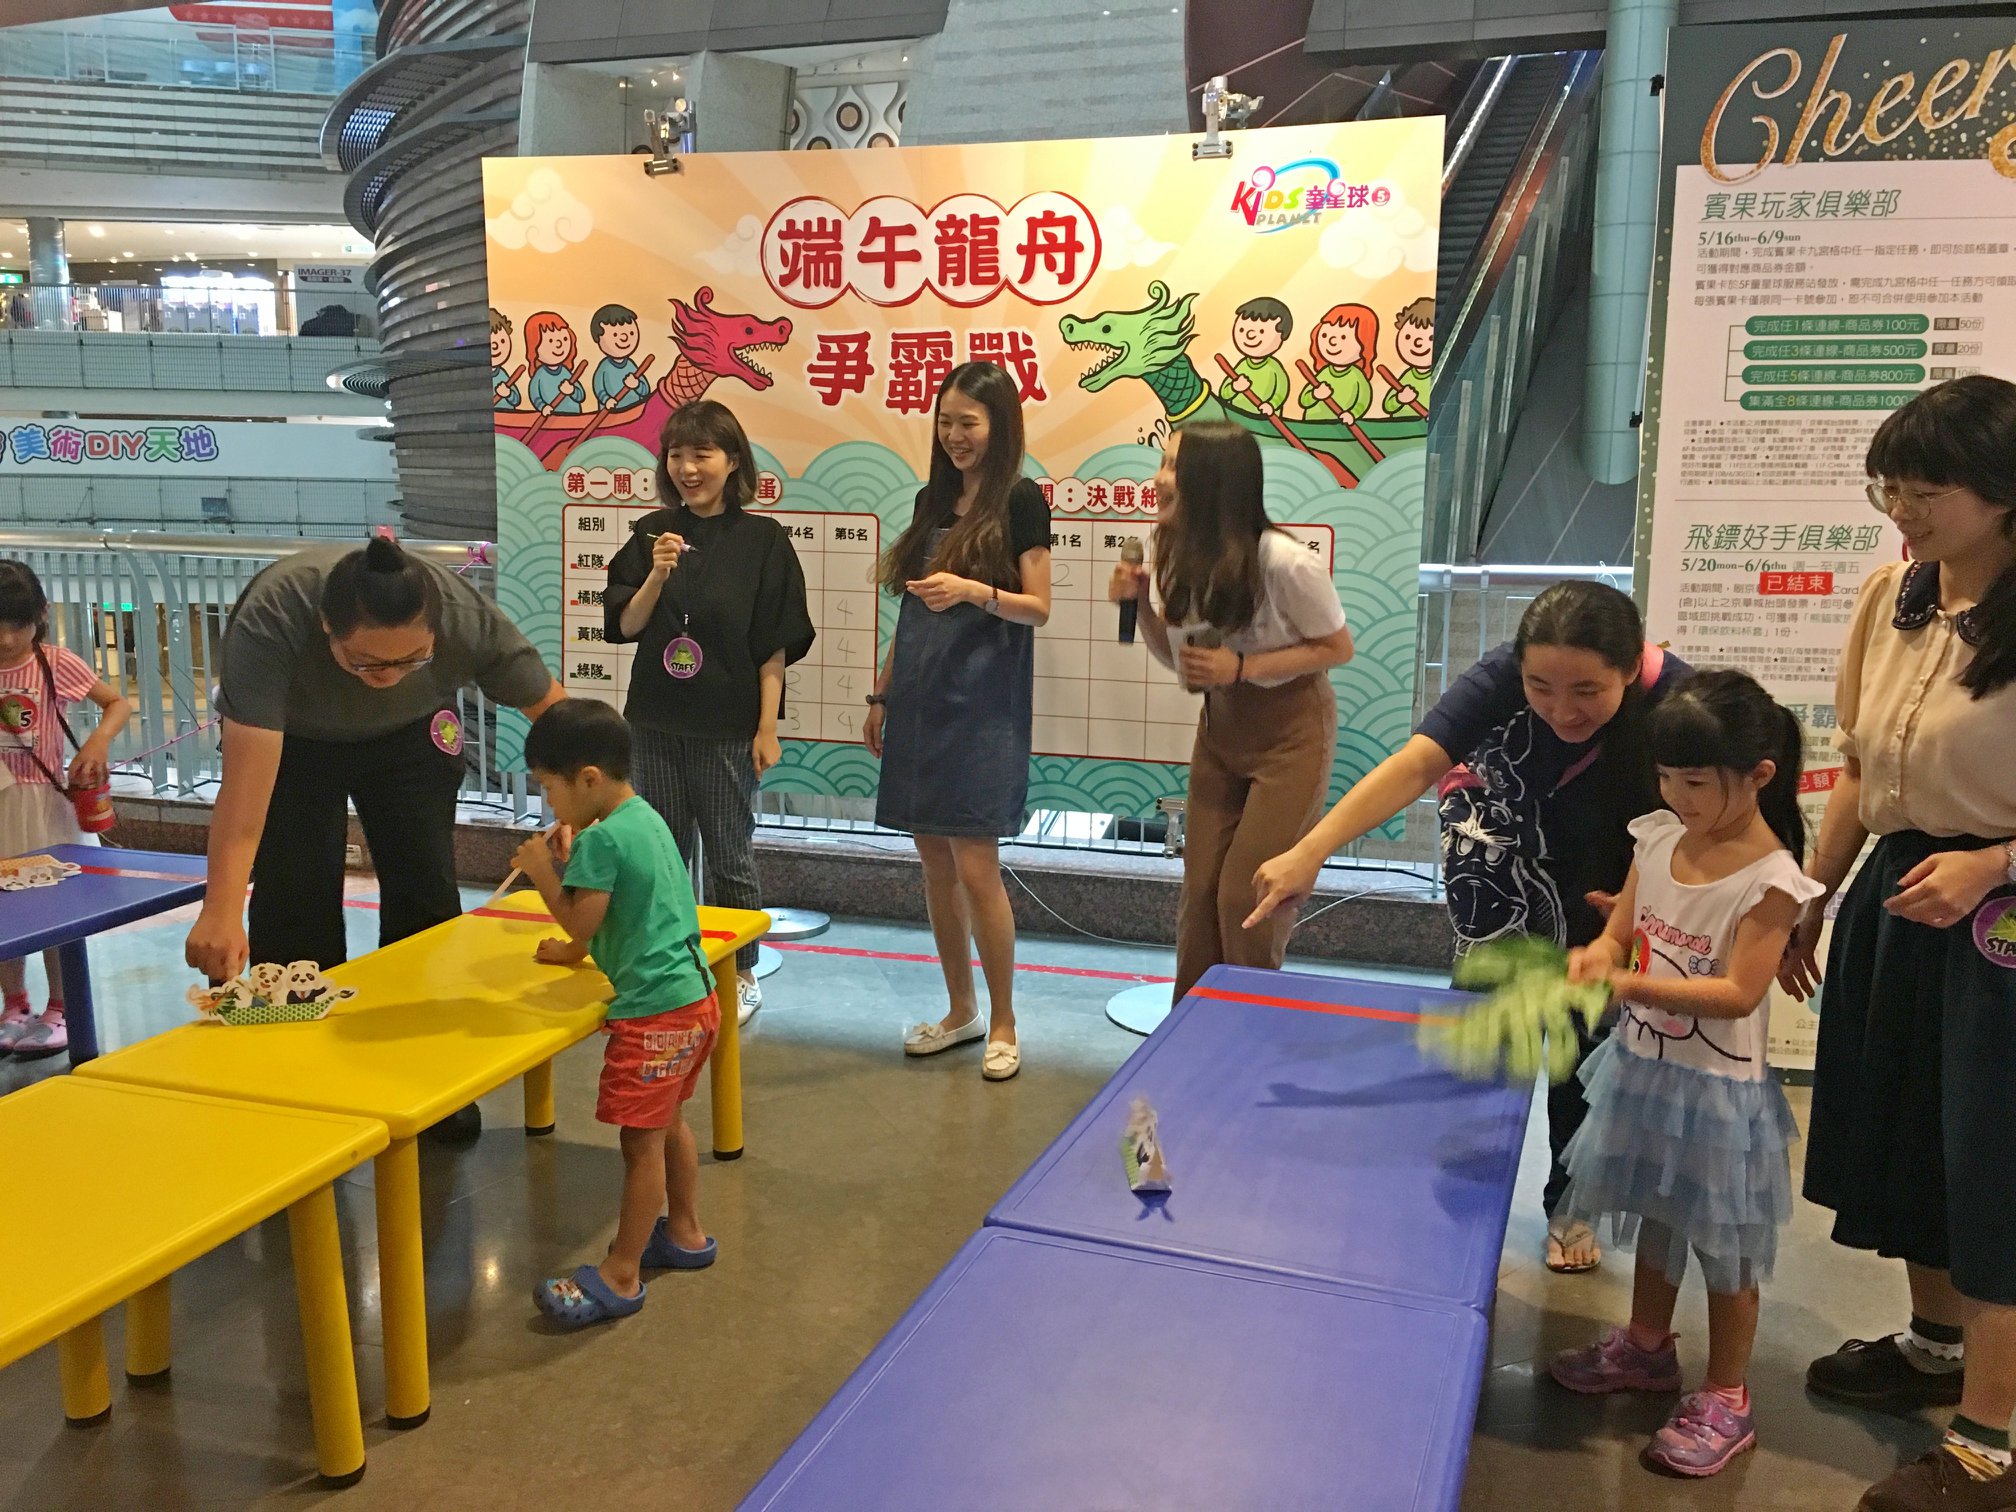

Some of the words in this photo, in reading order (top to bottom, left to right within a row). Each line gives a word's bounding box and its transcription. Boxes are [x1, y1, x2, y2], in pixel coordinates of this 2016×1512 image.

[1701, 189, 1901, 220] 賓果玩家俱樂部
[778, 210, 1084, 289] 端午龍舟
[298, 268, 352, 276] IMAGER-37
[807, 330, 1046, 414] 爭霸戰
[757, 478, 776, 499] 蛋
[578, 517, 605, 532] 組別
[783, 526, 814, 540] 第4名
[835, 527, 868, 541] 第5名
[1684, 524, 1883, 551] 飛鏢好手俱樂部
[1050, 533, 1081, 548] 第1名
[577, 553, 604, 568] 紅隊
[1767, 574, 1826, 592] 已結束
[1832, 585, 1860, 595] Card
[577, 590, 604, 605] 橘隊
[837, 598, 853, 625] 4
[577, 627, 604, 641] 黃隊
[837, 636, 856, 663] 4
[577, 663, 604, 677] 綠隊
[670, 662, 696, 672] STAFF
[837, 674, 853, 698] 4
[20, 711, 32, 727] 5
